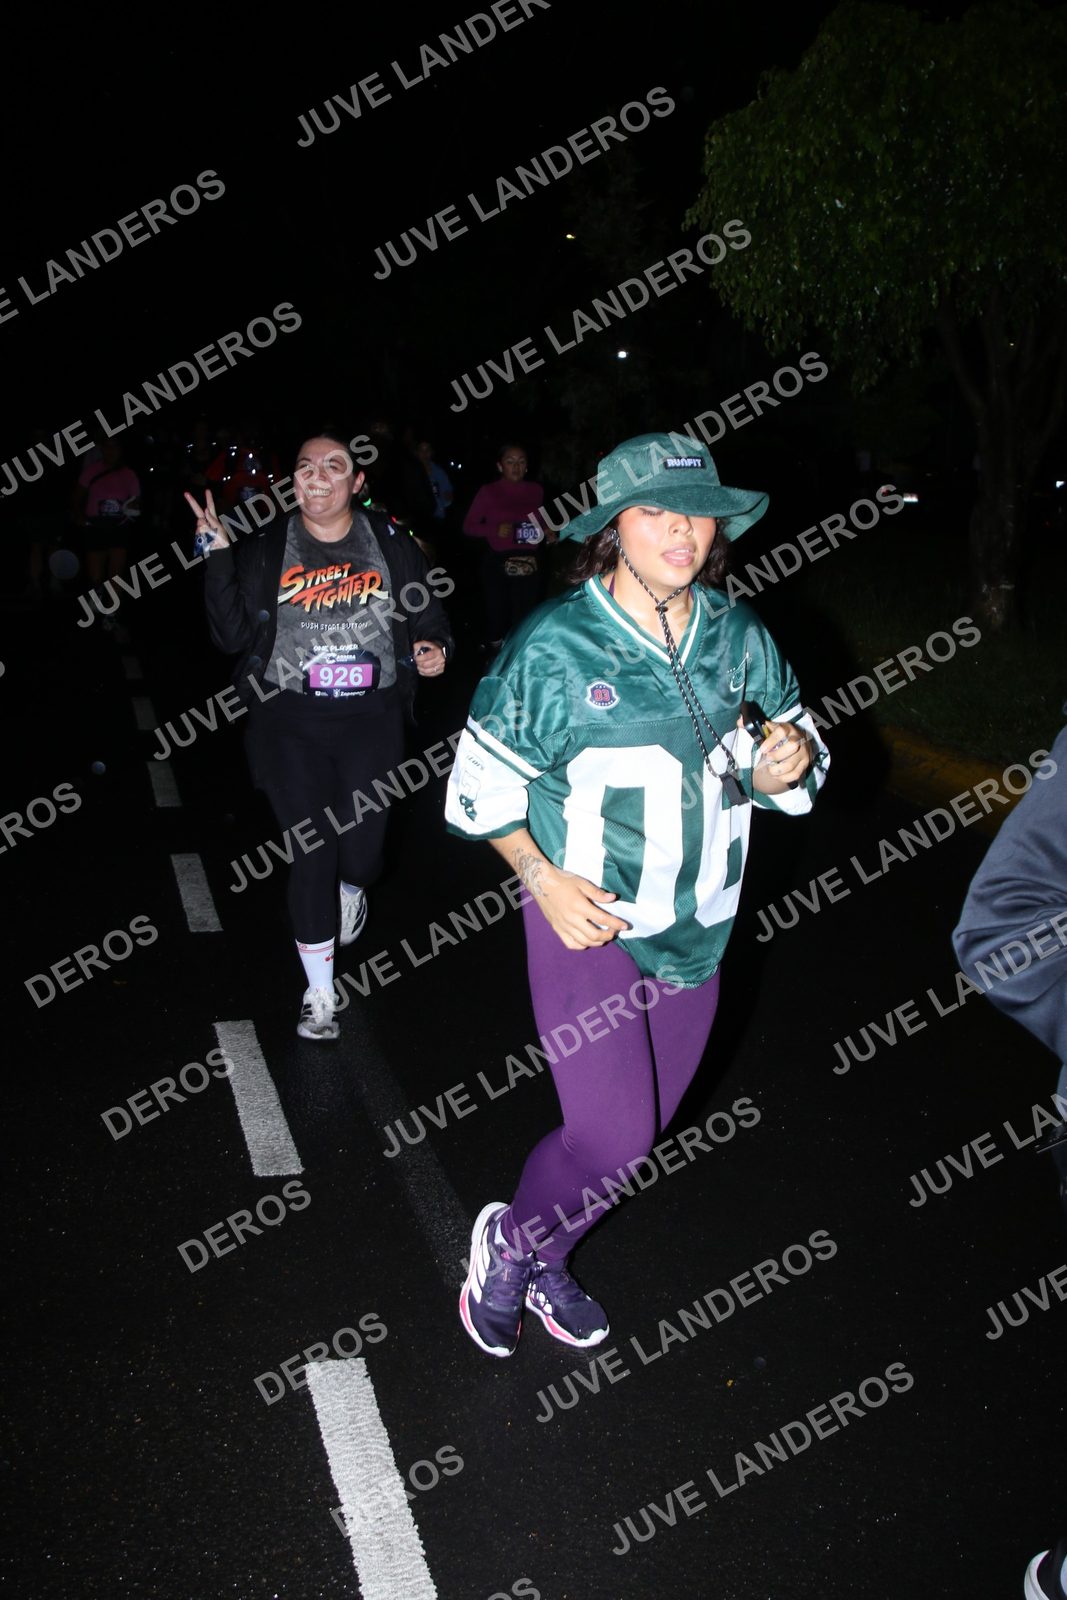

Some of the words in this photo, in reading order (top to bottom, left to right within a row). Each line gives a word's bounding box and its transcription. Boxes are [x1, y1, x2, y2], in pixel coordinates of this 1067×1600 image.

[517, 528, 540, 539] 1603
[277, 562, 351, 604] STREET
[289, 569, 388, 613] FIGHTER
[300, 621, 319, 630] PUSH
[319, 666, 363, 687] 926
